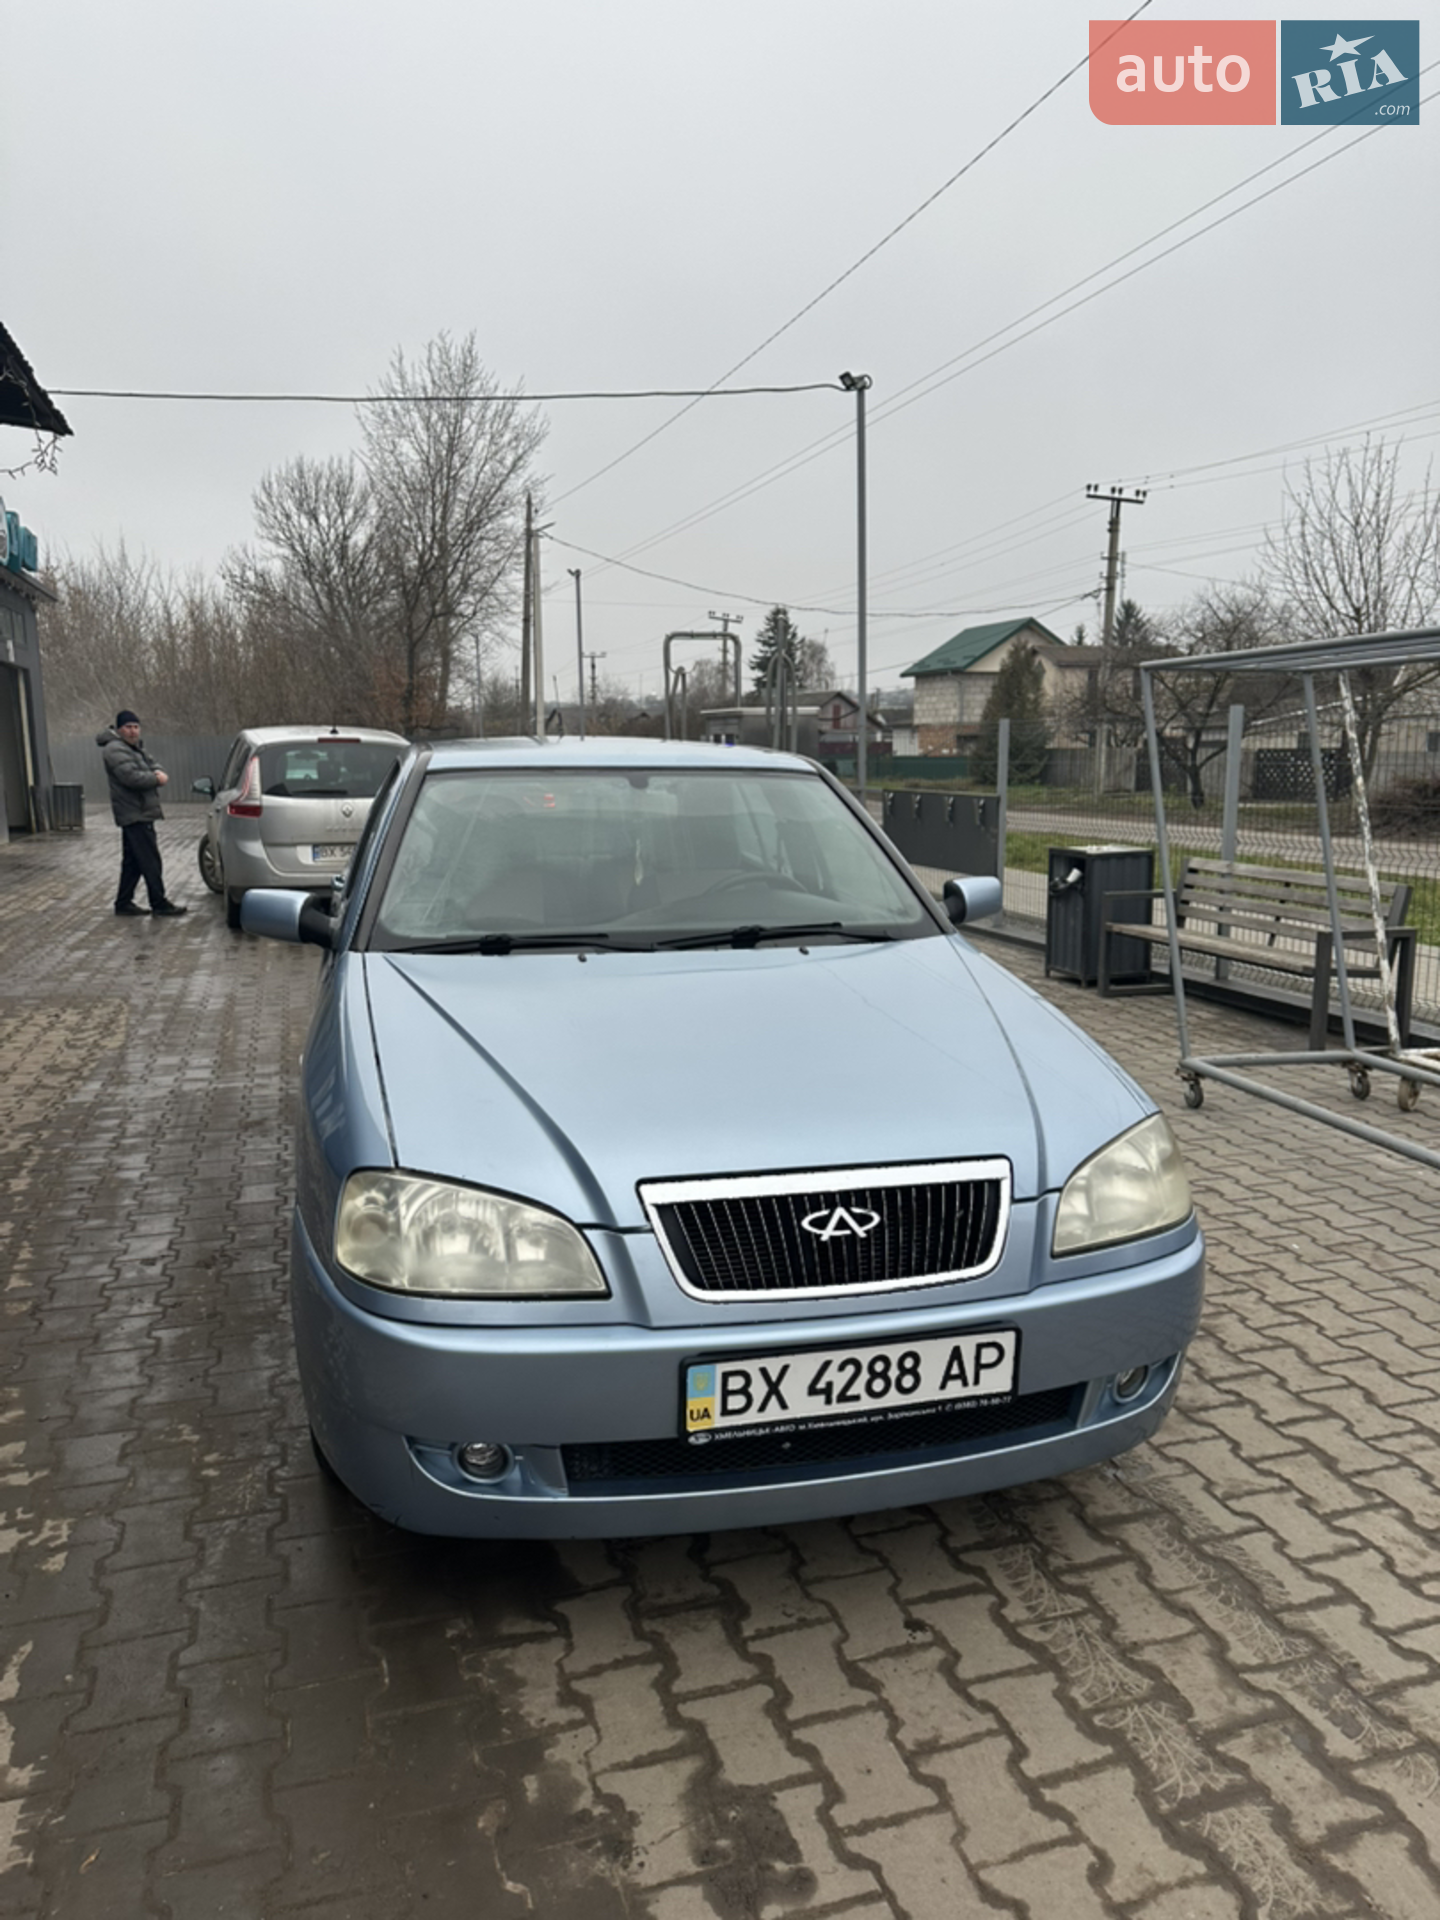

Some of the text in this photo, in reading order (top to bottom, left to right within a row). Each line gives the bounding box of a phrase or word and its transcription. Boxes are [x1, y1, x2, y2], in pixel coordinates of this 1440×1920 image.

[720, 1341, 1005, 1417] BX 4288 AP
[690, 1407, 712, 1422] UA
